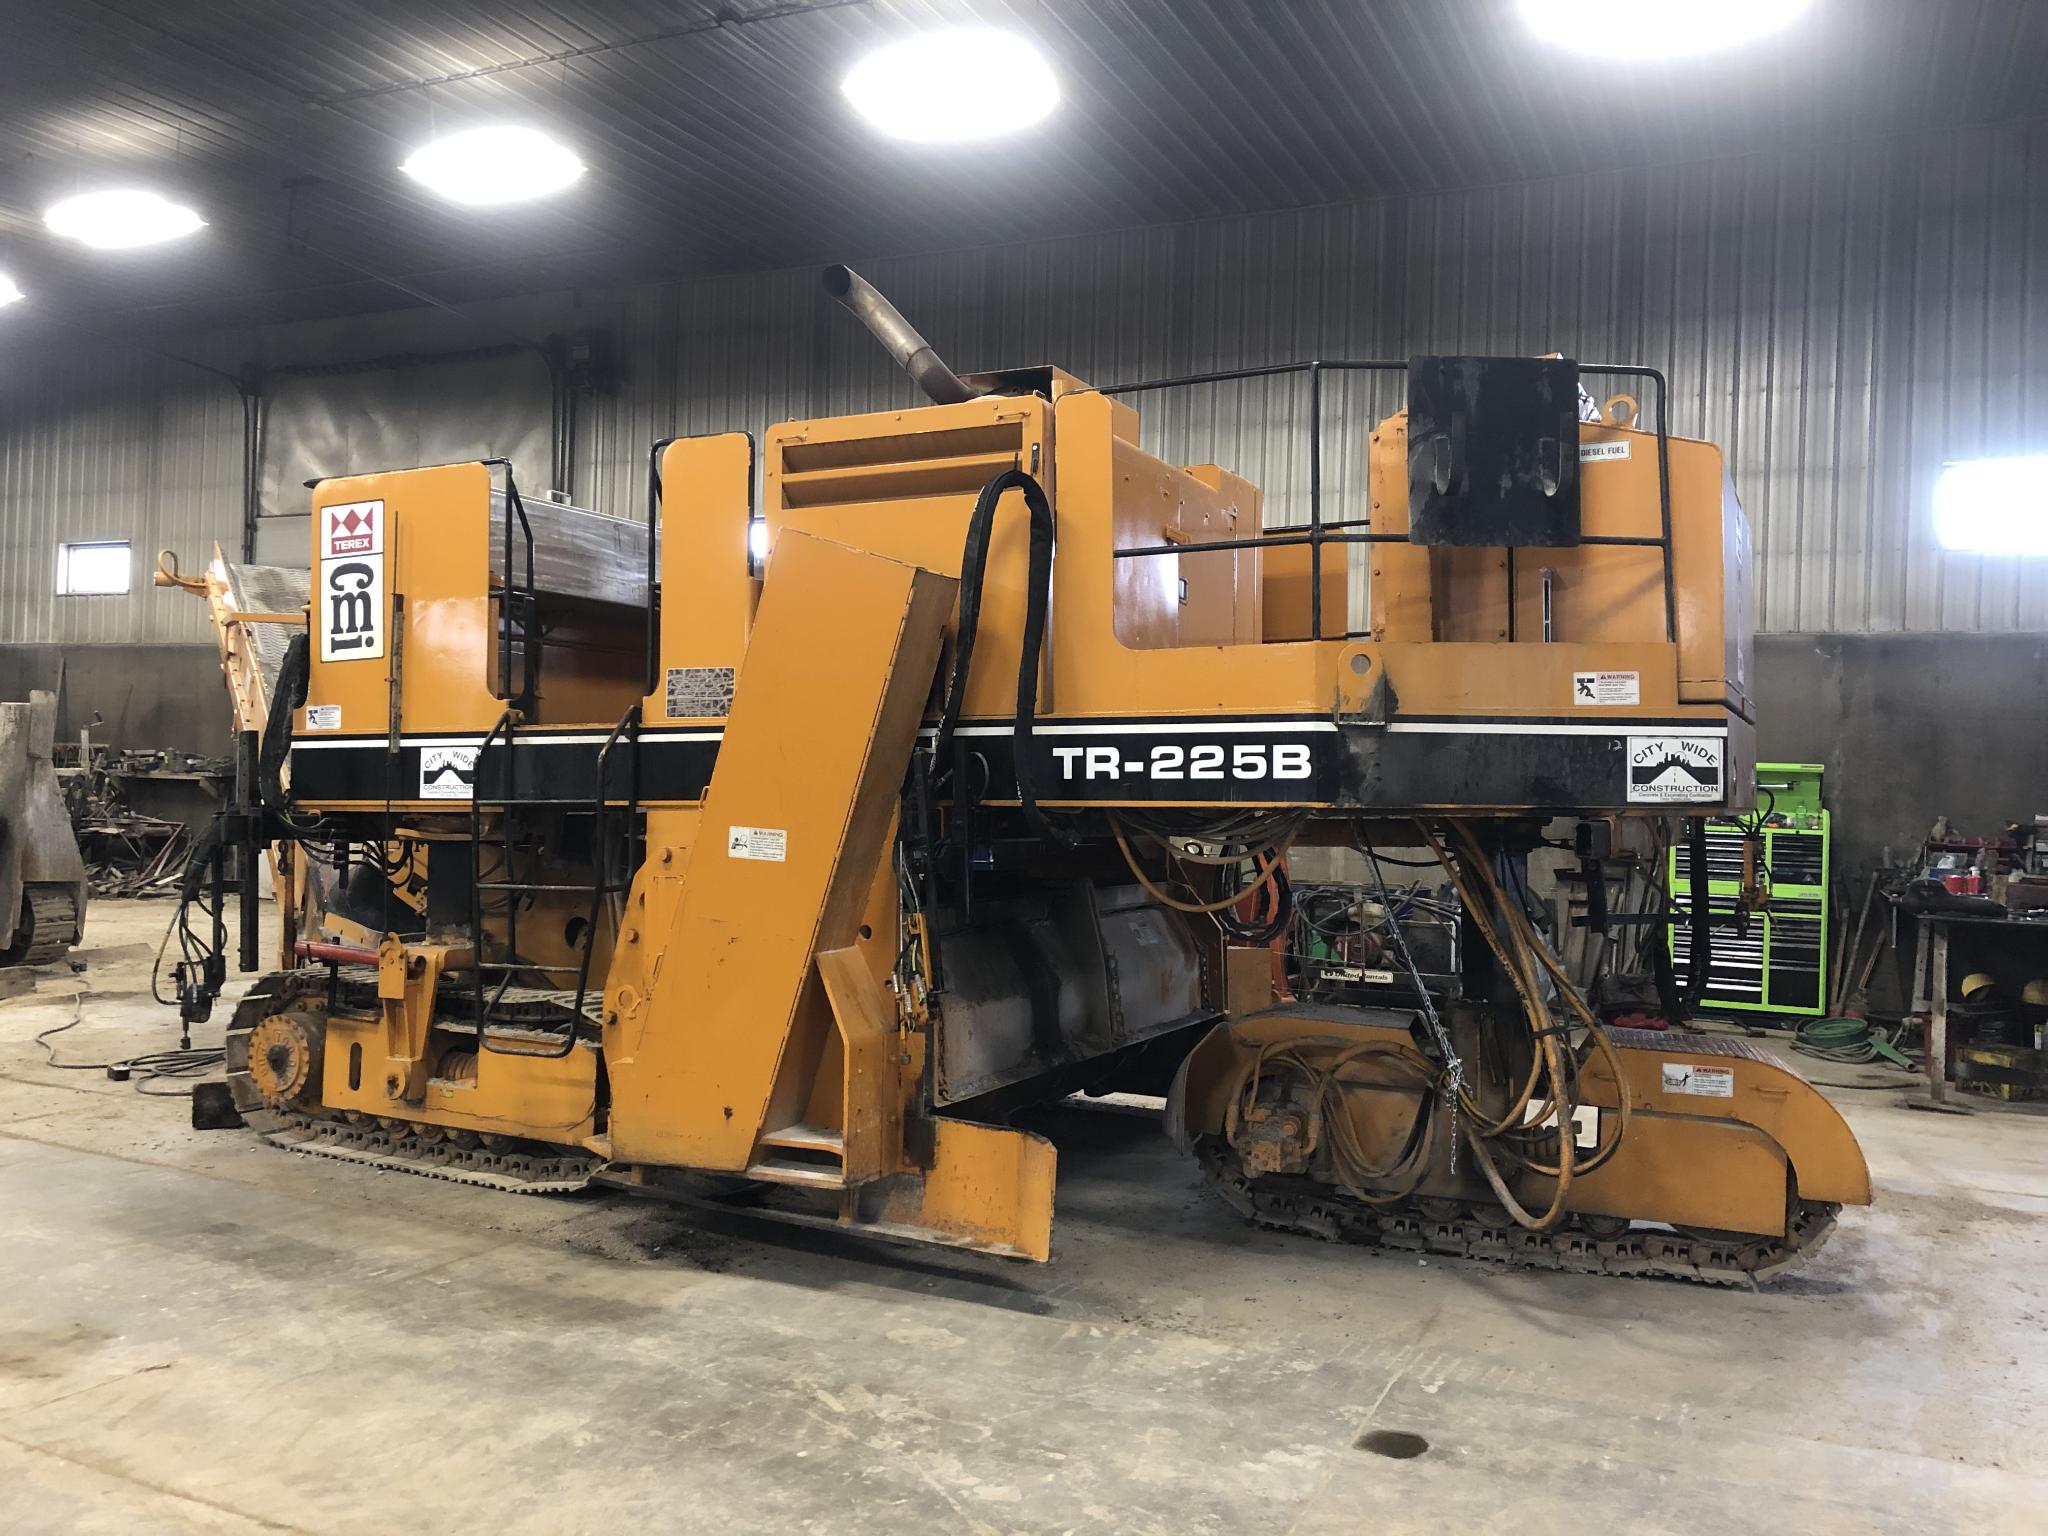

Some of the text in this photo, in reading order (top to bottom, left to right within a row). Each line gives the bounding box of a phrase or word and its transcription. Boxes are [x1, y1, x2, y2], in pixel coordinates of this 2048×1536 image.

[1580, 446, 1625, 457] DIESEL FUEL
[334, 537, 370, 551] TEREX
[424, 750, 474, 769] CITY WIDE
[1633, 740, 1718, 766] CITY WIDE
[1052, 744, 1312, 780] TR-225B
[1632, 784, 1719, 792] CONSTRUCTION
[758, 830, 784, 838] WARNING
